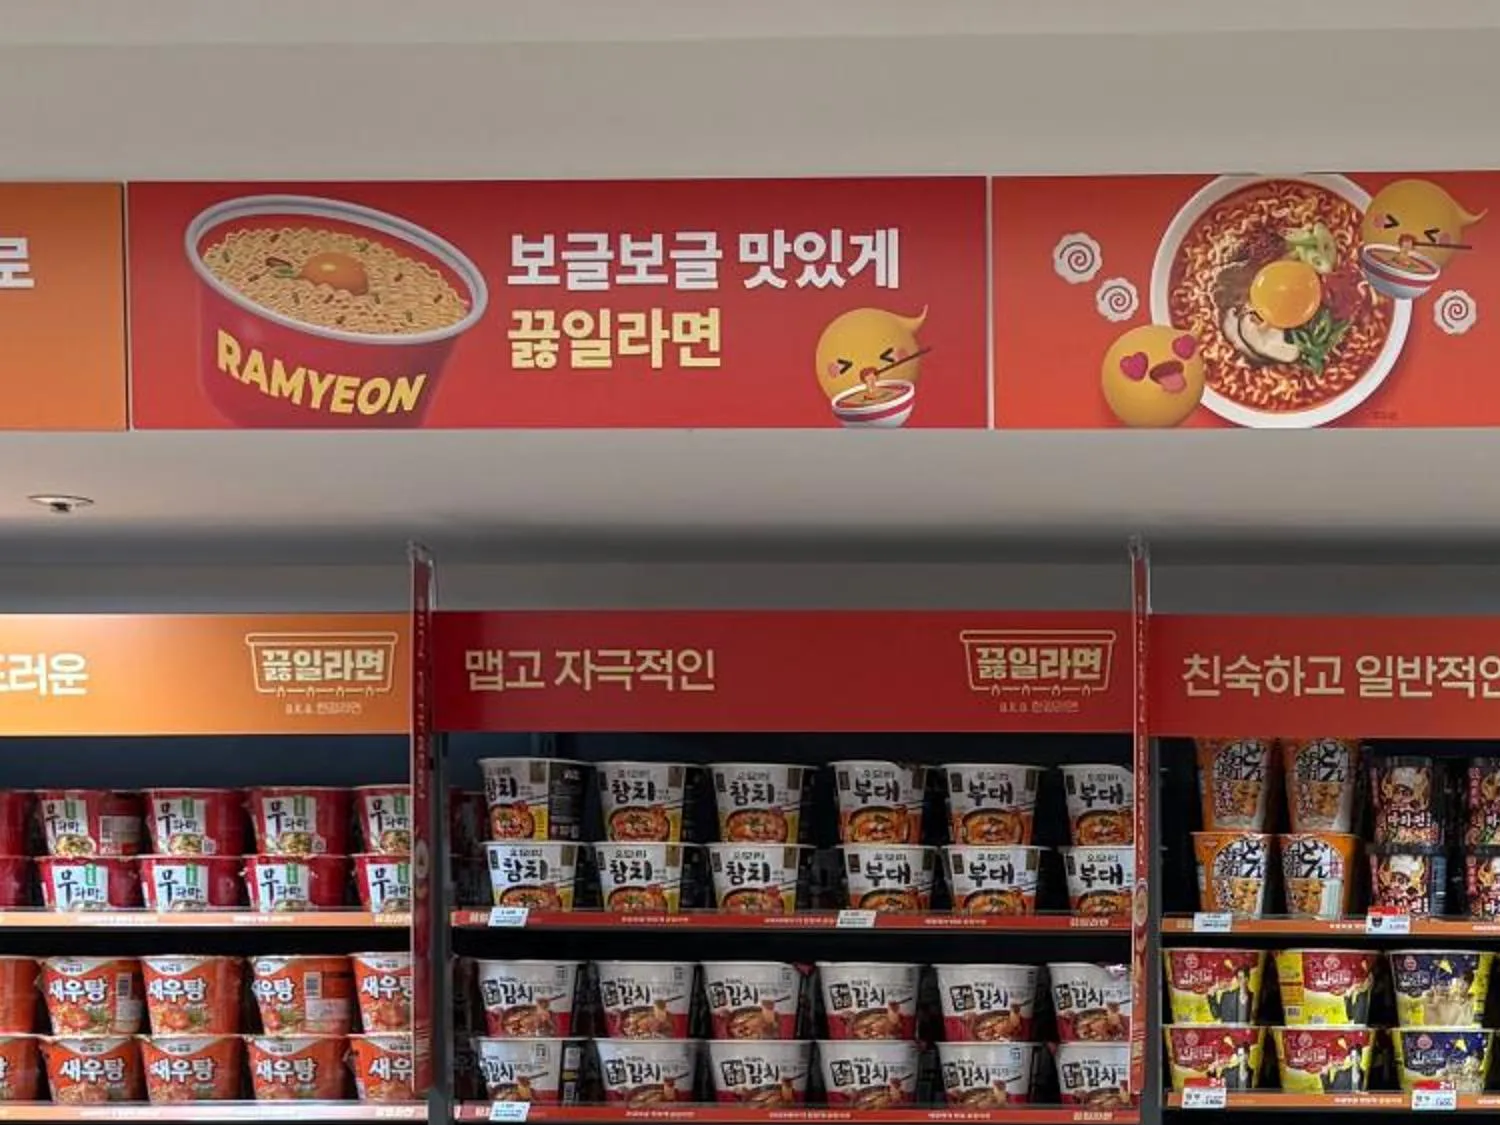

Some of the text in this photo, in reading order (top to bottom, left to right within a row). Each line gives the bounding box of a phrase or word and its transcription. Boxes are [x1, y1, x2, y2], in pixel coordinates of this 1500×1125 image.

[508, 229, 901, 291] 보글보글 맛있게
[508, 308, 721, 370] 끓일라면
[216, 328, 427, 416] RAMYEON
[261, 650, 385, 682] 끓일라면
[466, 648, 715, 692] 맵고 자극적인
[977, 647, 1102, 680] 끓일라면
[1182, 655, 1345, 699] 친숙하고
[854, 781, 899, 804] 부대
[1080, 784, 1124, 807] 부대
[865, 863, 911, 887] 부대
[968, 864, 1014, 887] 부대
[1080, 864, 1124, 887] 부대
[60, 1057, 125, 1083] 새우탕
[150, 1056, 215, 1082] 새우탕
